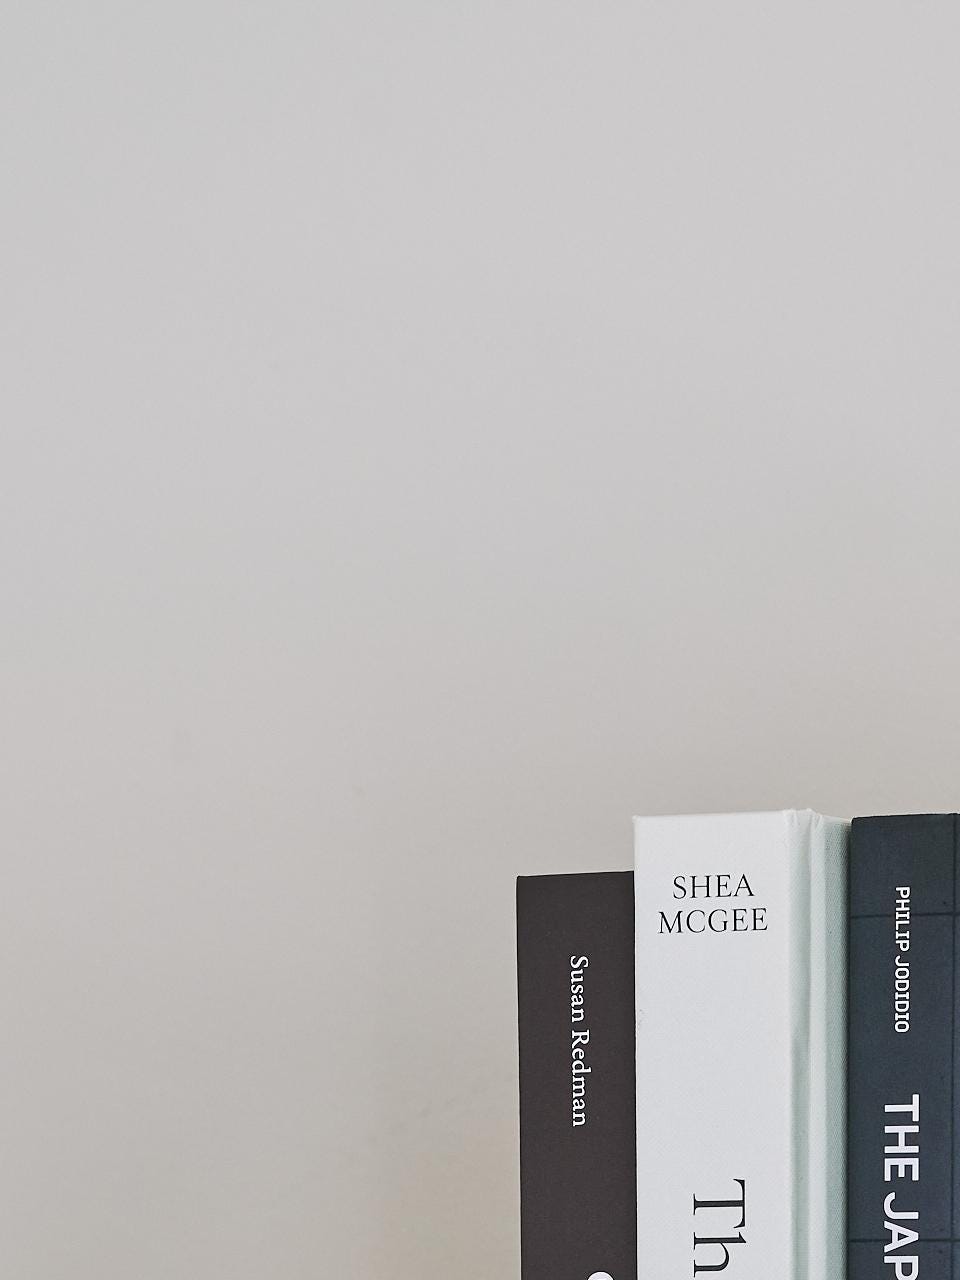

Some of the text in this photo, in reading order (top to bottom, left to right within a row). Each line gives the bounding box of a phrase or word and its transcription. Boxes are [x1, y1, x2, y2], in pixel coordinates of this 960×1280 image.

[659, 907, 768, 934] MCGEE
[672, 873, 755, 900] SHEA
[894, 886, 911, 1033] PHILIP JODIDIO
[570, 955, 592, 1127] Susan Redman
[883, 1094, 920, 1182] THE
